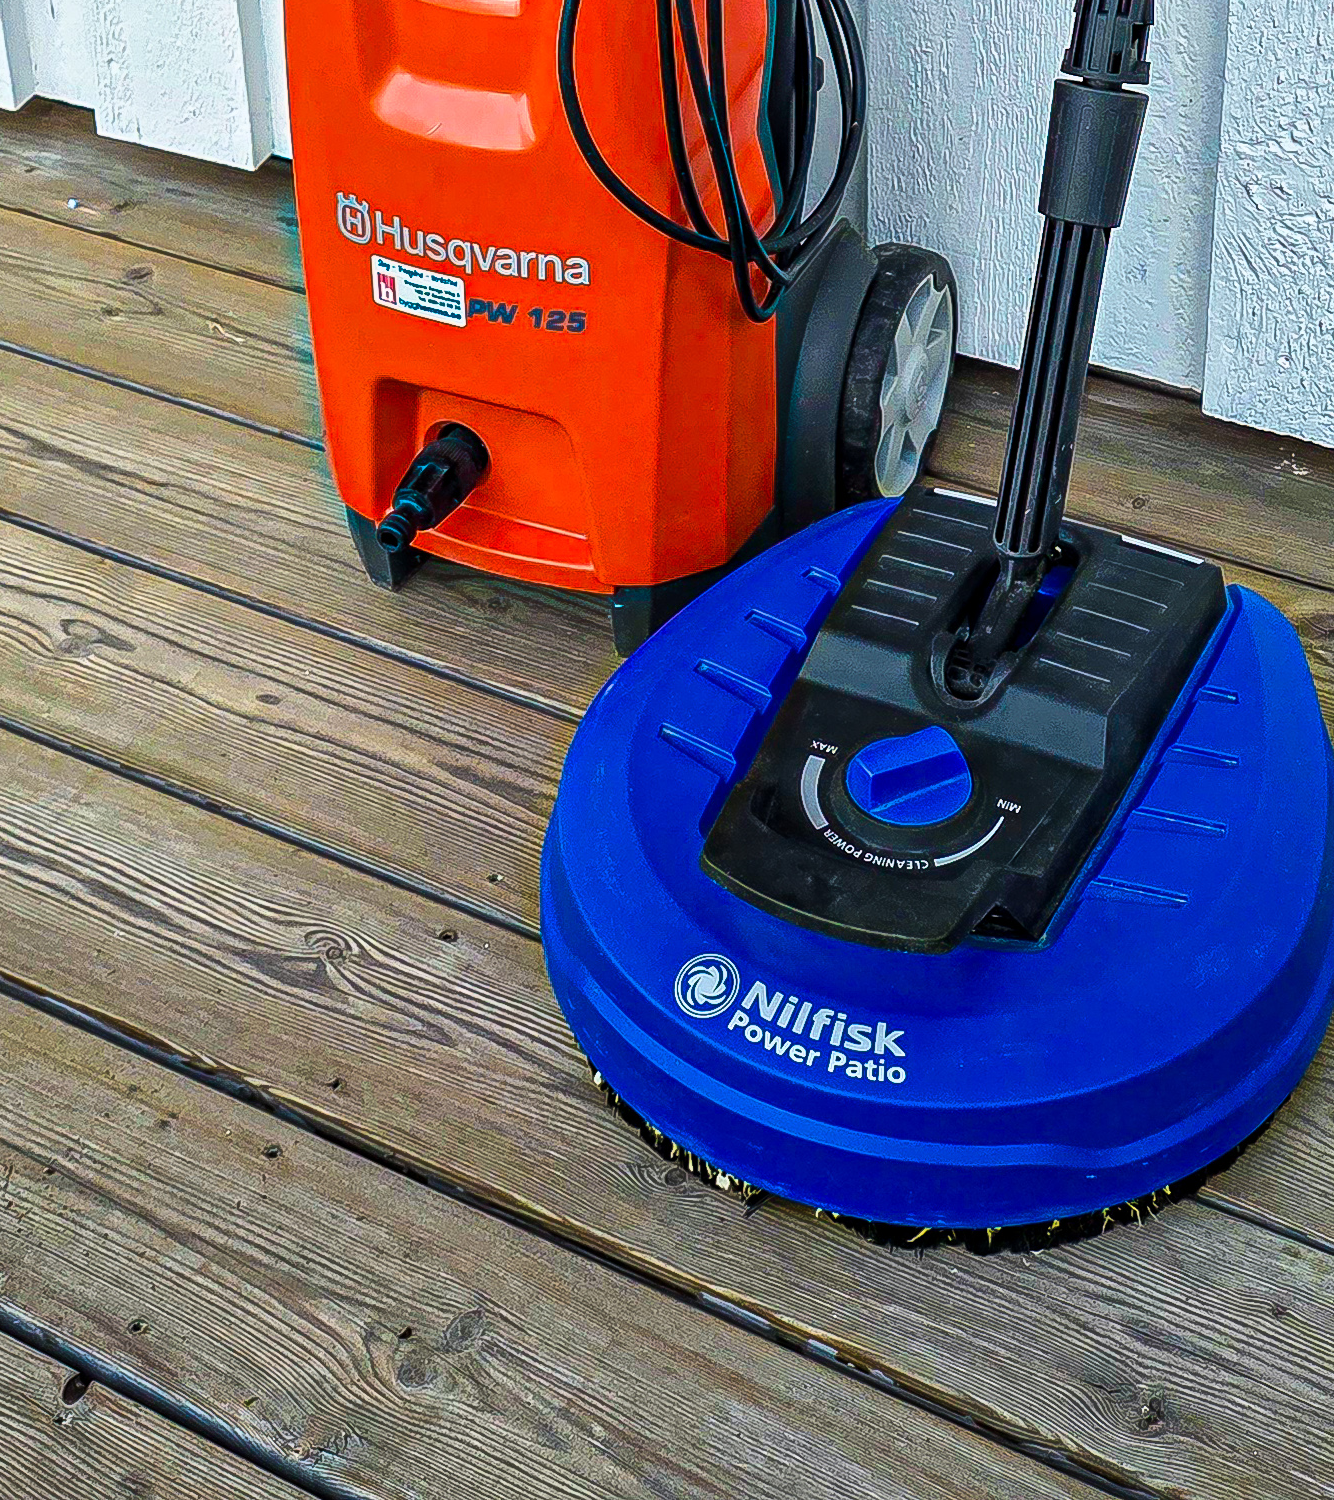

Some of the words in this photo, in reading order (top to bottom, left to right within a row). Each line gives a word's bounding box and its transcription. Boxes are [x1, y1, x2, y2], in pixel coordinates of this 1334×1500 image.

[375, 210, 591, 285] Husqvarna
[468, 298, 518, 325] PW
[527, 307, 587, 333] 125
[811, 739, 838, 755] MAX
[997, 798, 1021, 814] MIN
[823, 828, 863, 859] POWER
[864, 852, 929, 870] CLEANING
[740, 980, 906, 1057] Nilfisk
[727, 1009, 820, 1067] Power
[827, 1050, 907, 1084] Patio
